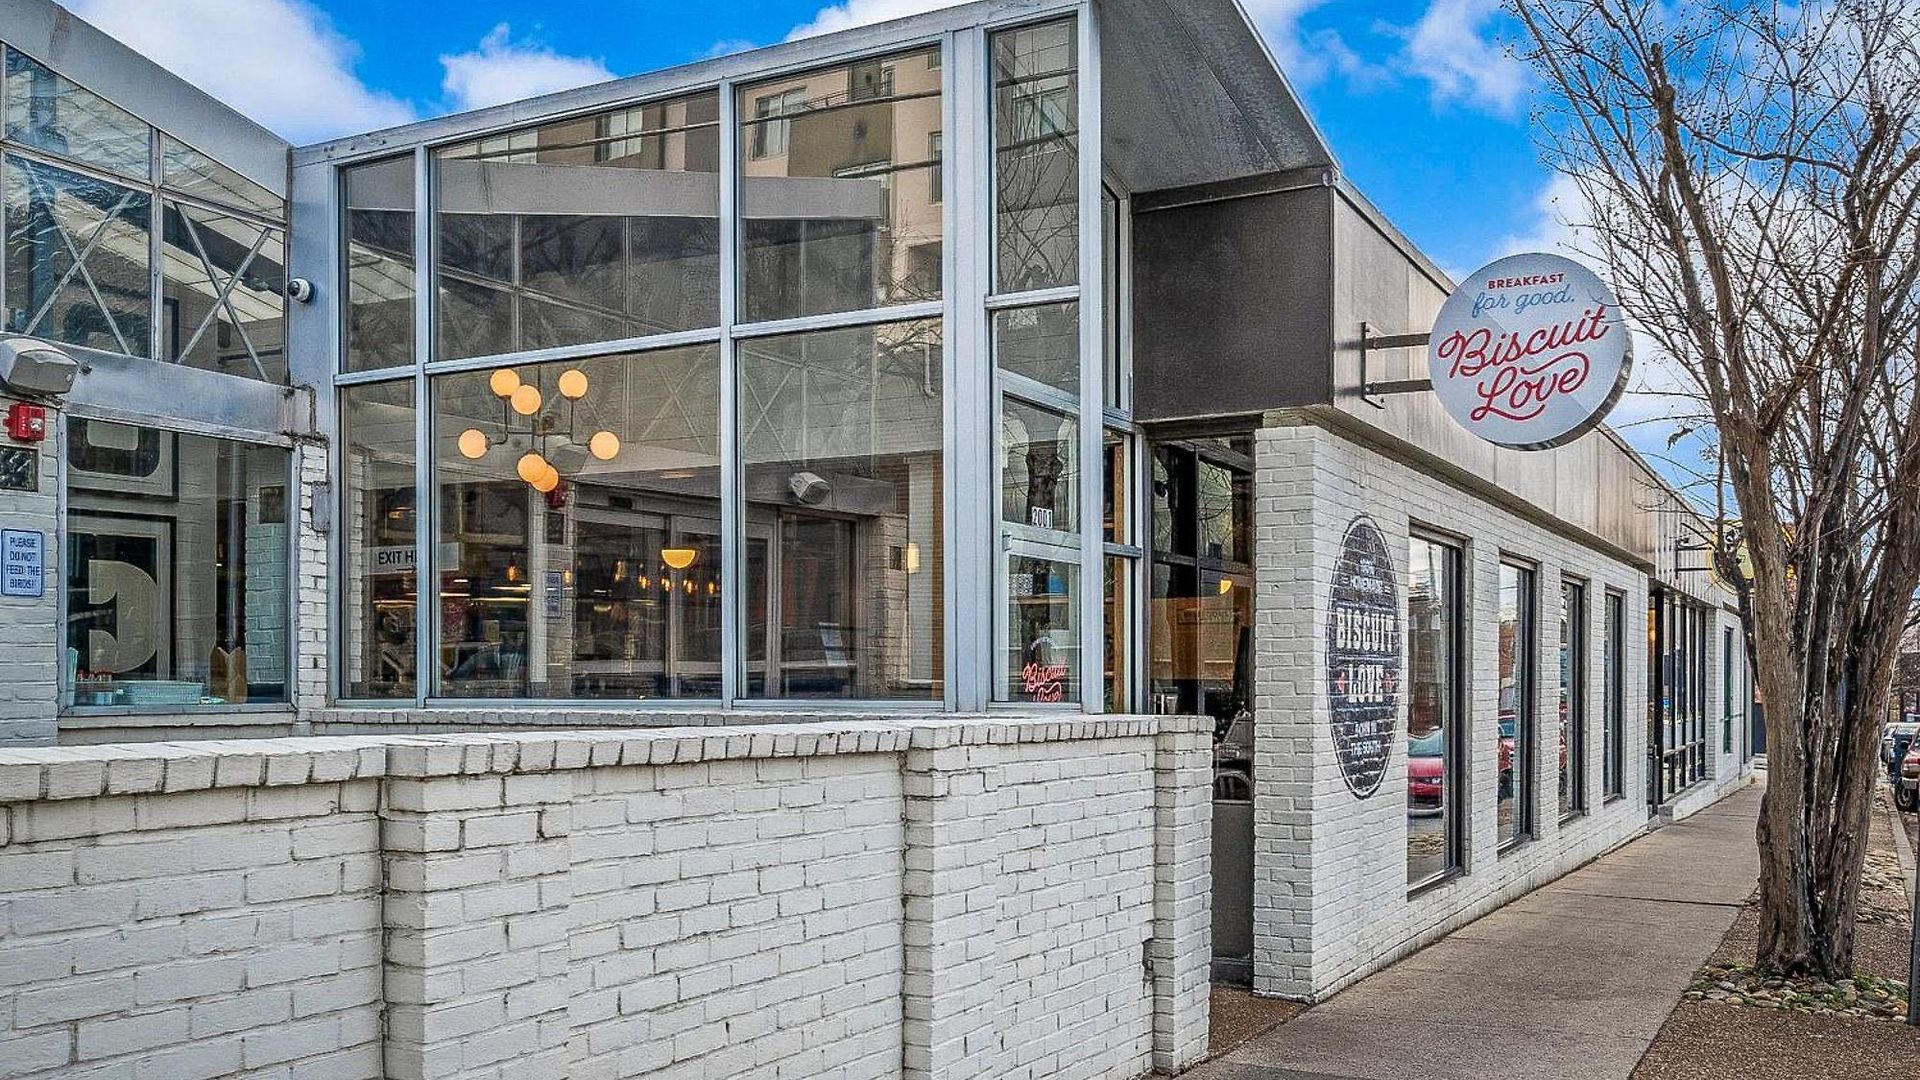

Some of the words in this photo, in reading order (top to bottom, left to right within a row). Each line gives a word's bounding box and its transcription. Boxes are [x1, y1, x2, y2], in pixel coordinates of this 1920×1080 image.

[1488, 273, 1564, 290] BREAKFAST
[1472, 291, 1510, 318] for
[1515, 284, 1575, 315] good.
[1437, 303, 1610, 378] Biscuit
[1470, 351, 1590, 421] Love
[1032, 507, 1052, 528] 2001
[9, 536, 37, 548] PLEASE
[6, 564, 24, 575] FEED
[27, 565, 40, 576] THE
[9, 551, 20, 561] DO
[21, 552, 36, 562] NOT
[378, 551, 402, 564] EXIT
[1336, 607, 1395, 653] BISCUIT
[1022, 656, 1067, 693] Biscuit
[1348, 663, 1384, 703] LOVE
